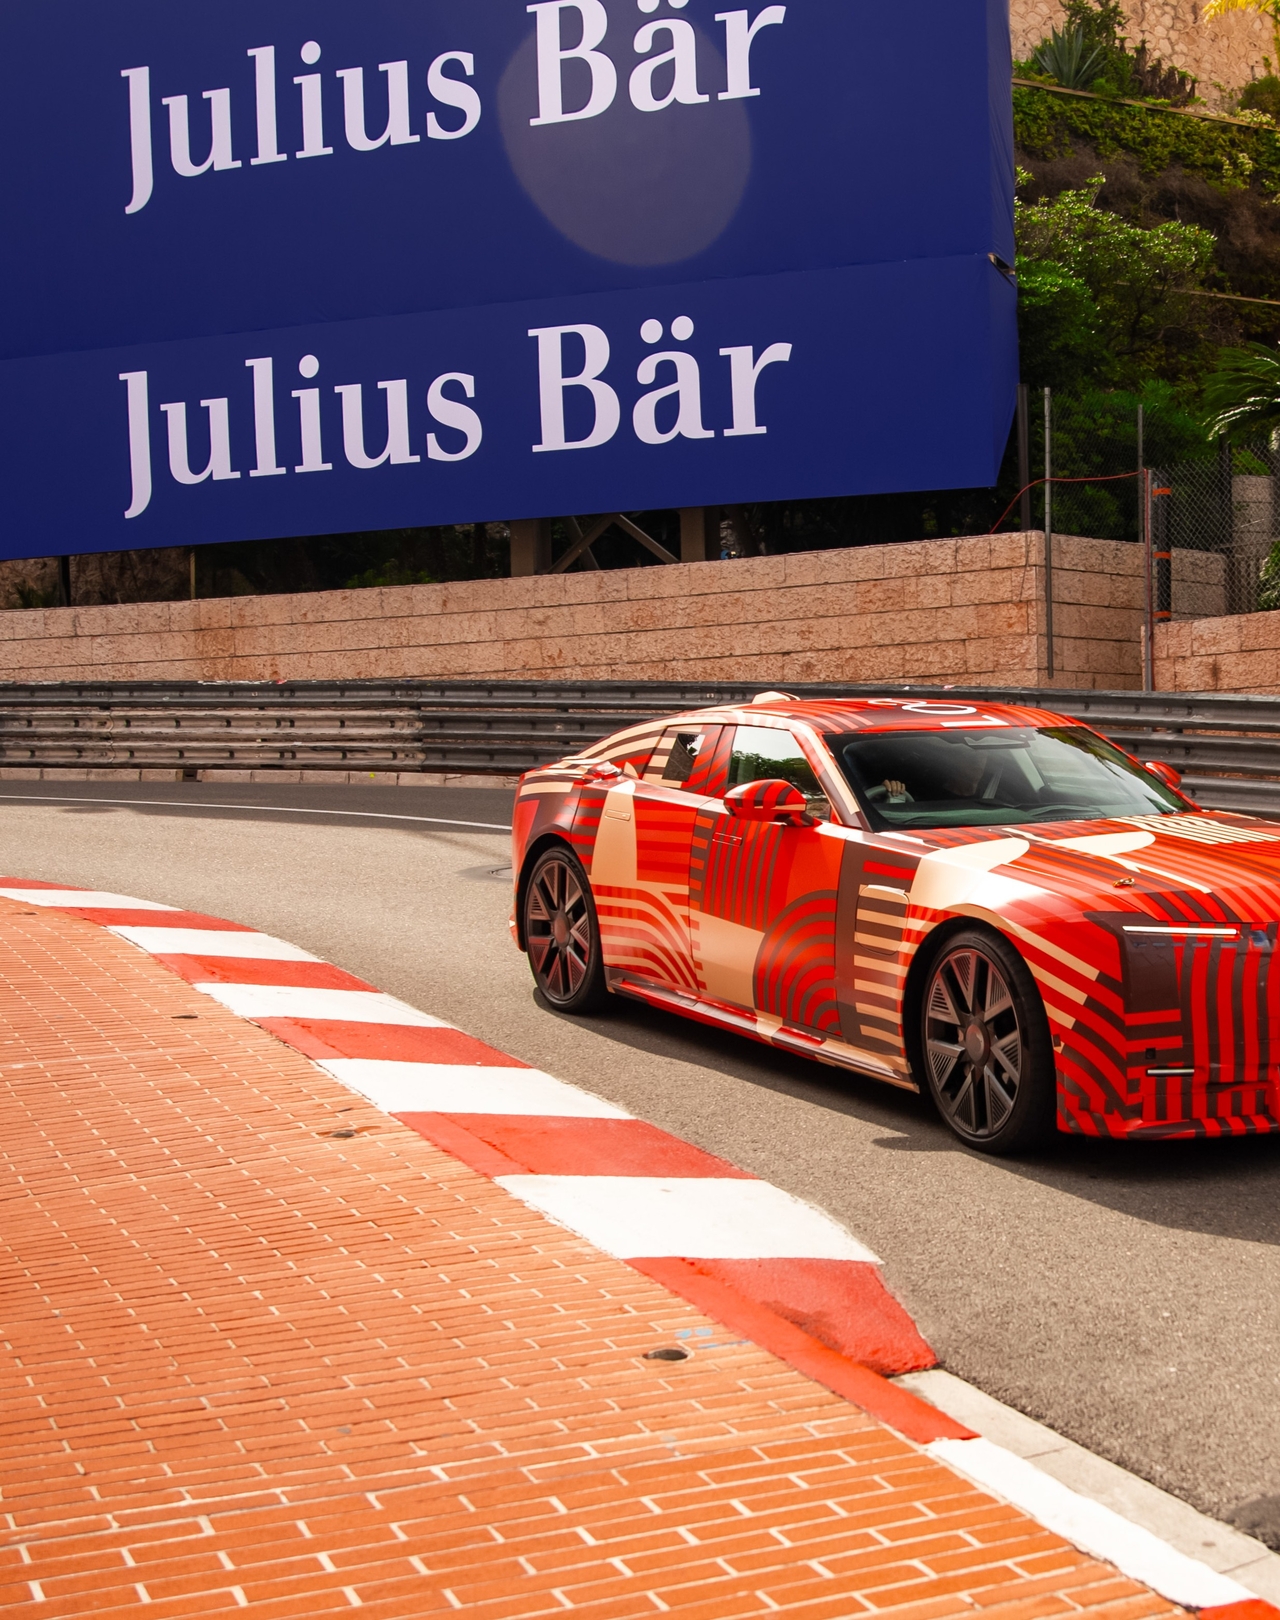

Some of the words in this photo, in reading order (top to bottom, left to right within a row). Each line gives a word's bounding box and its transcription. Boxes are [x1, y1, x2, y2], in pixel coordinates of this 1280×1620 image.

[120, 40, 482, 214] Julius
[526, 0, 787, 127] Bär
[119, 354, 483, 519] Julius
[527, 315, 793, 453] Bär
